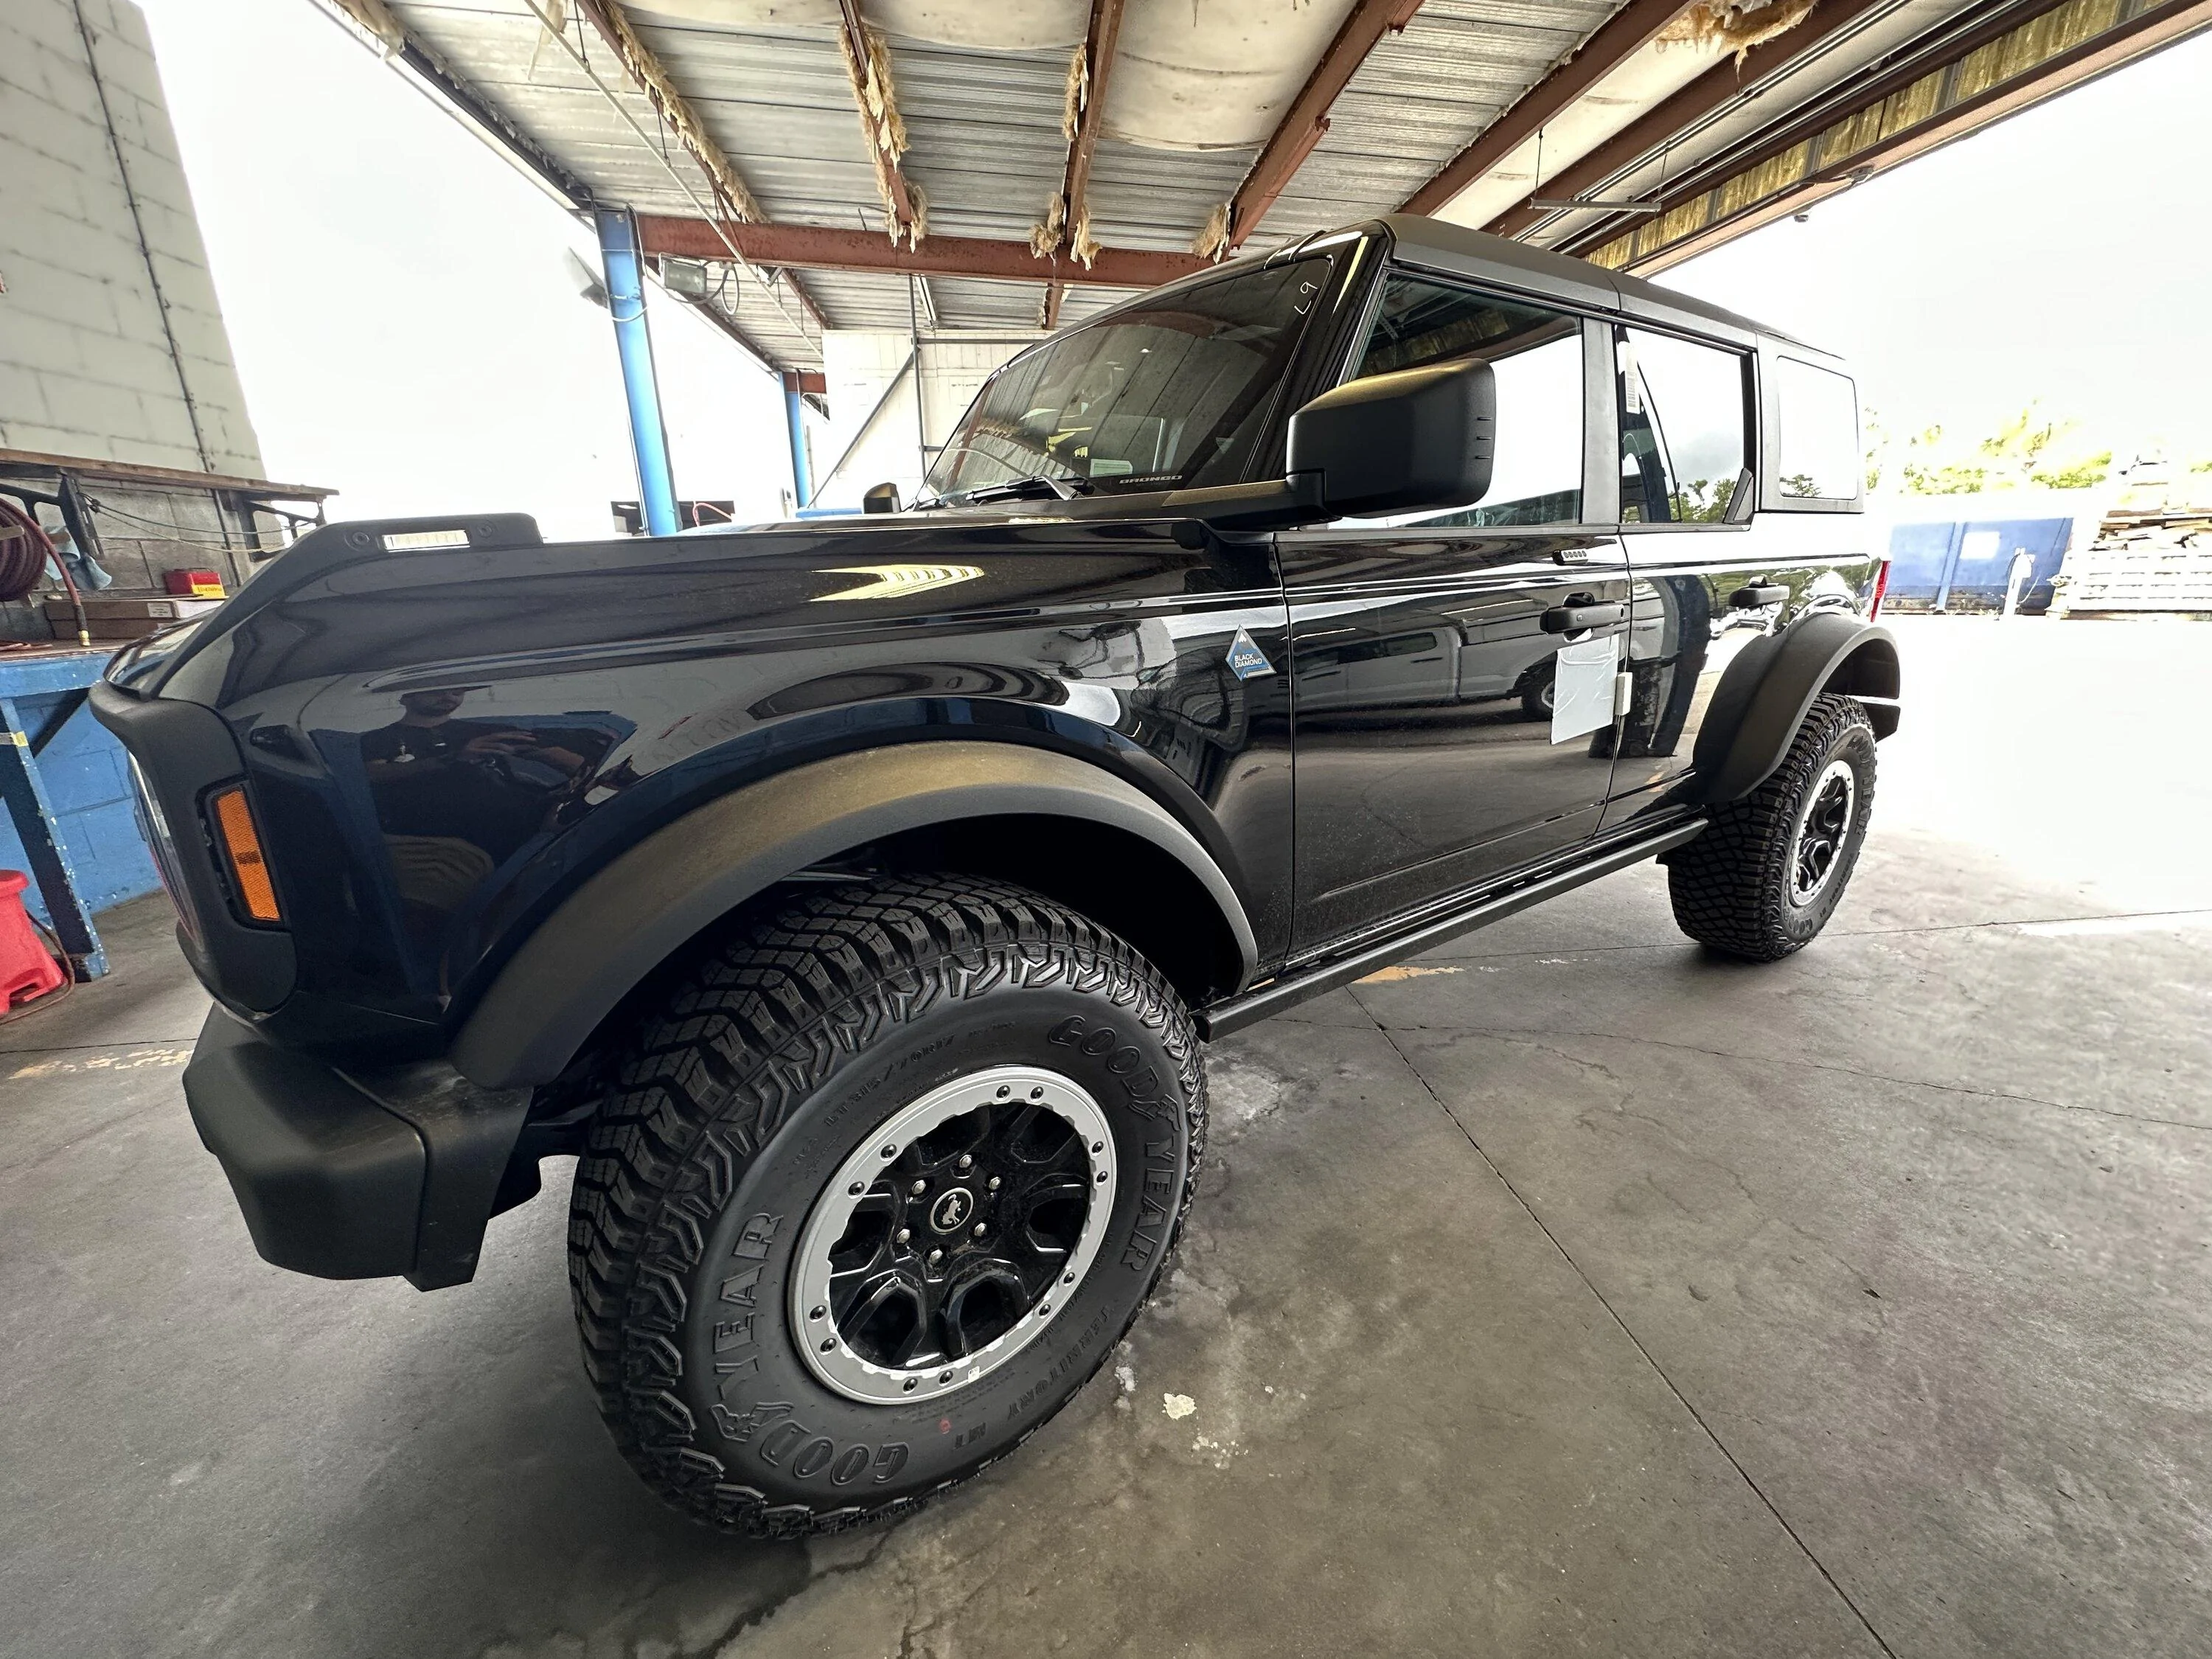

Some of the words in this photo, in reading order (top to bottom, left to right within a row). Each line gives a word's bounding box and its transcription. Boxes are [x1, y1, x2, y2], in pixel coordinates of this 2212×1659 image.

[1119, 474, 1183, 484] BRONCO
[1234, 653, 1253, 661] BLACK
[1235, 658, 1262, 668] DIAMOND
[1048, 1015, 1178, 1272] GOODYEAR
[713, 1213, 909, 1486] GOODYEAR
